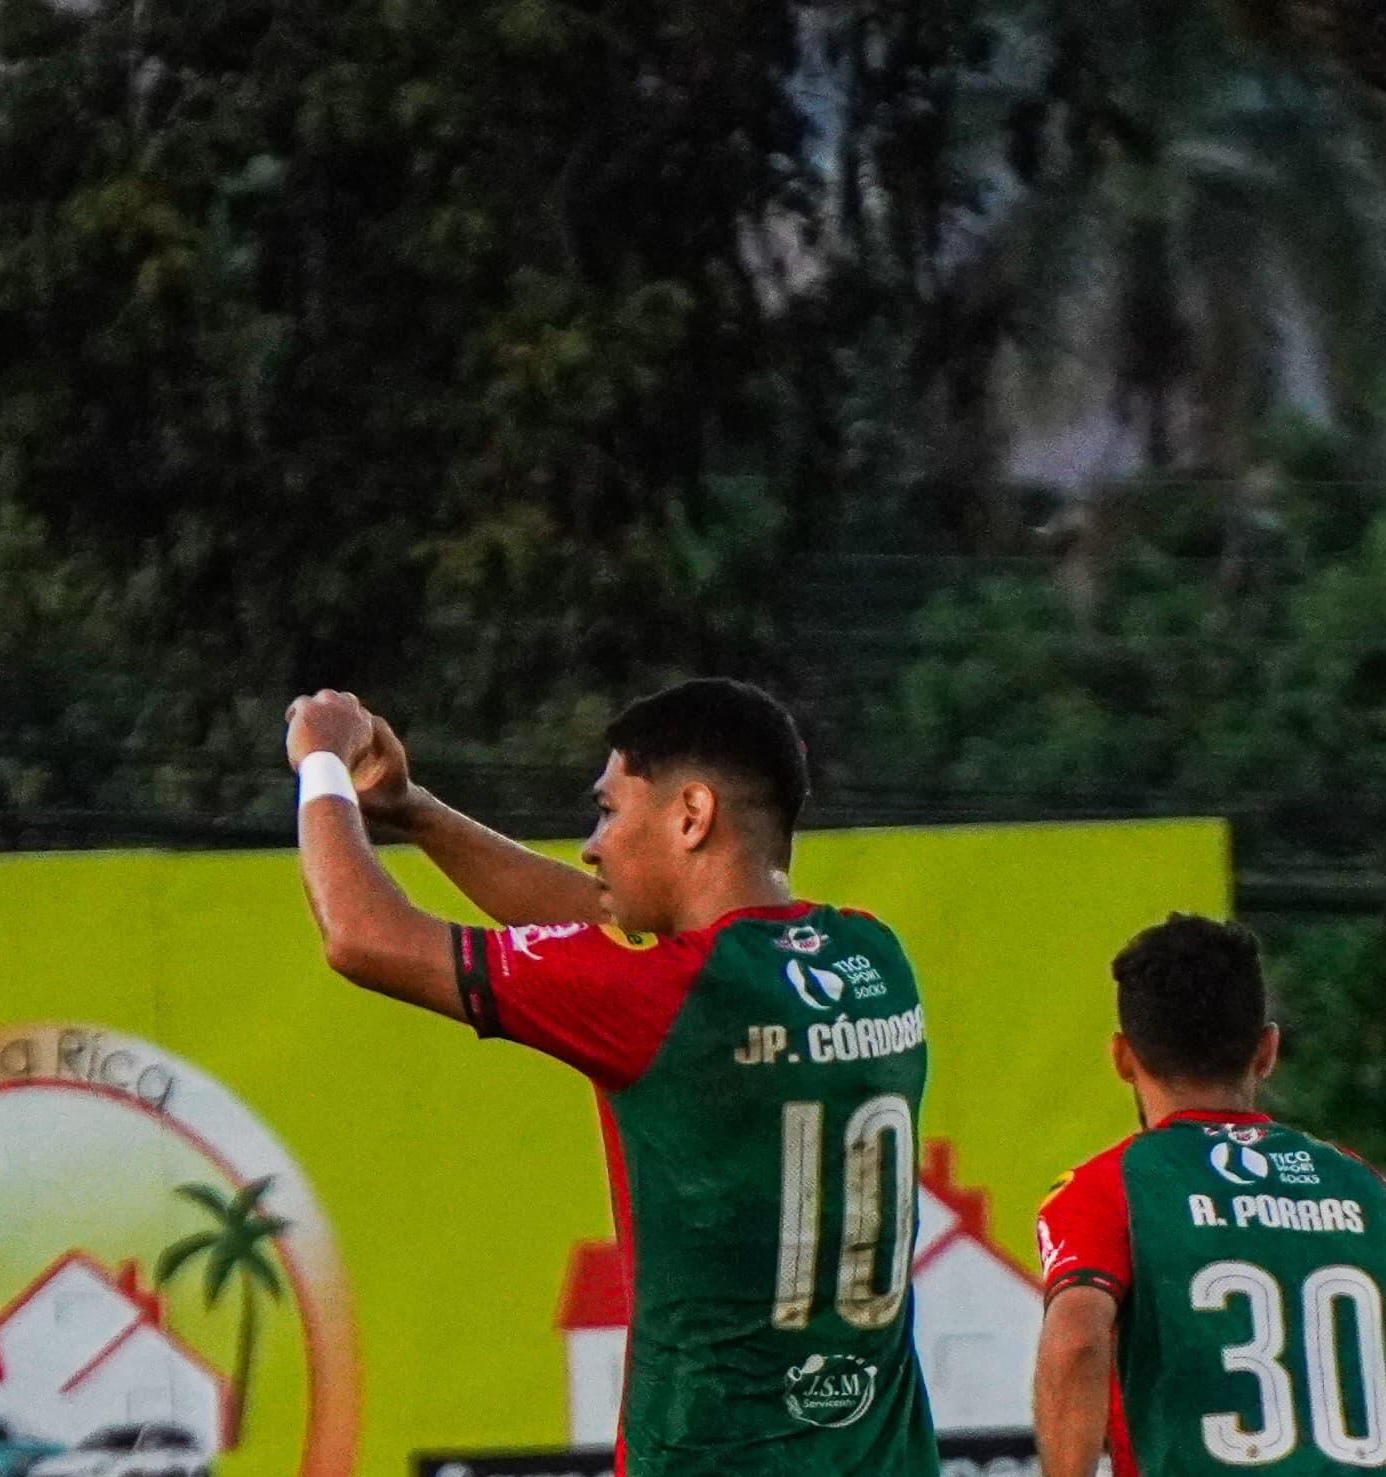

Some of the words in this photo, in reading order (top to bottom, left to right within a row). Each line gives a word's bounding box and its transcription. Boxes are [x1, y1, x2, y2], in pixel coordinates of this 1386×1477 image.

[56, 1028, 175, 1112] Rica
[734, 1024, 800, 1065] JP.
[772, 1092, 914, 1331] 10
[1231, 1194, 1365, 1233] PORRAS
